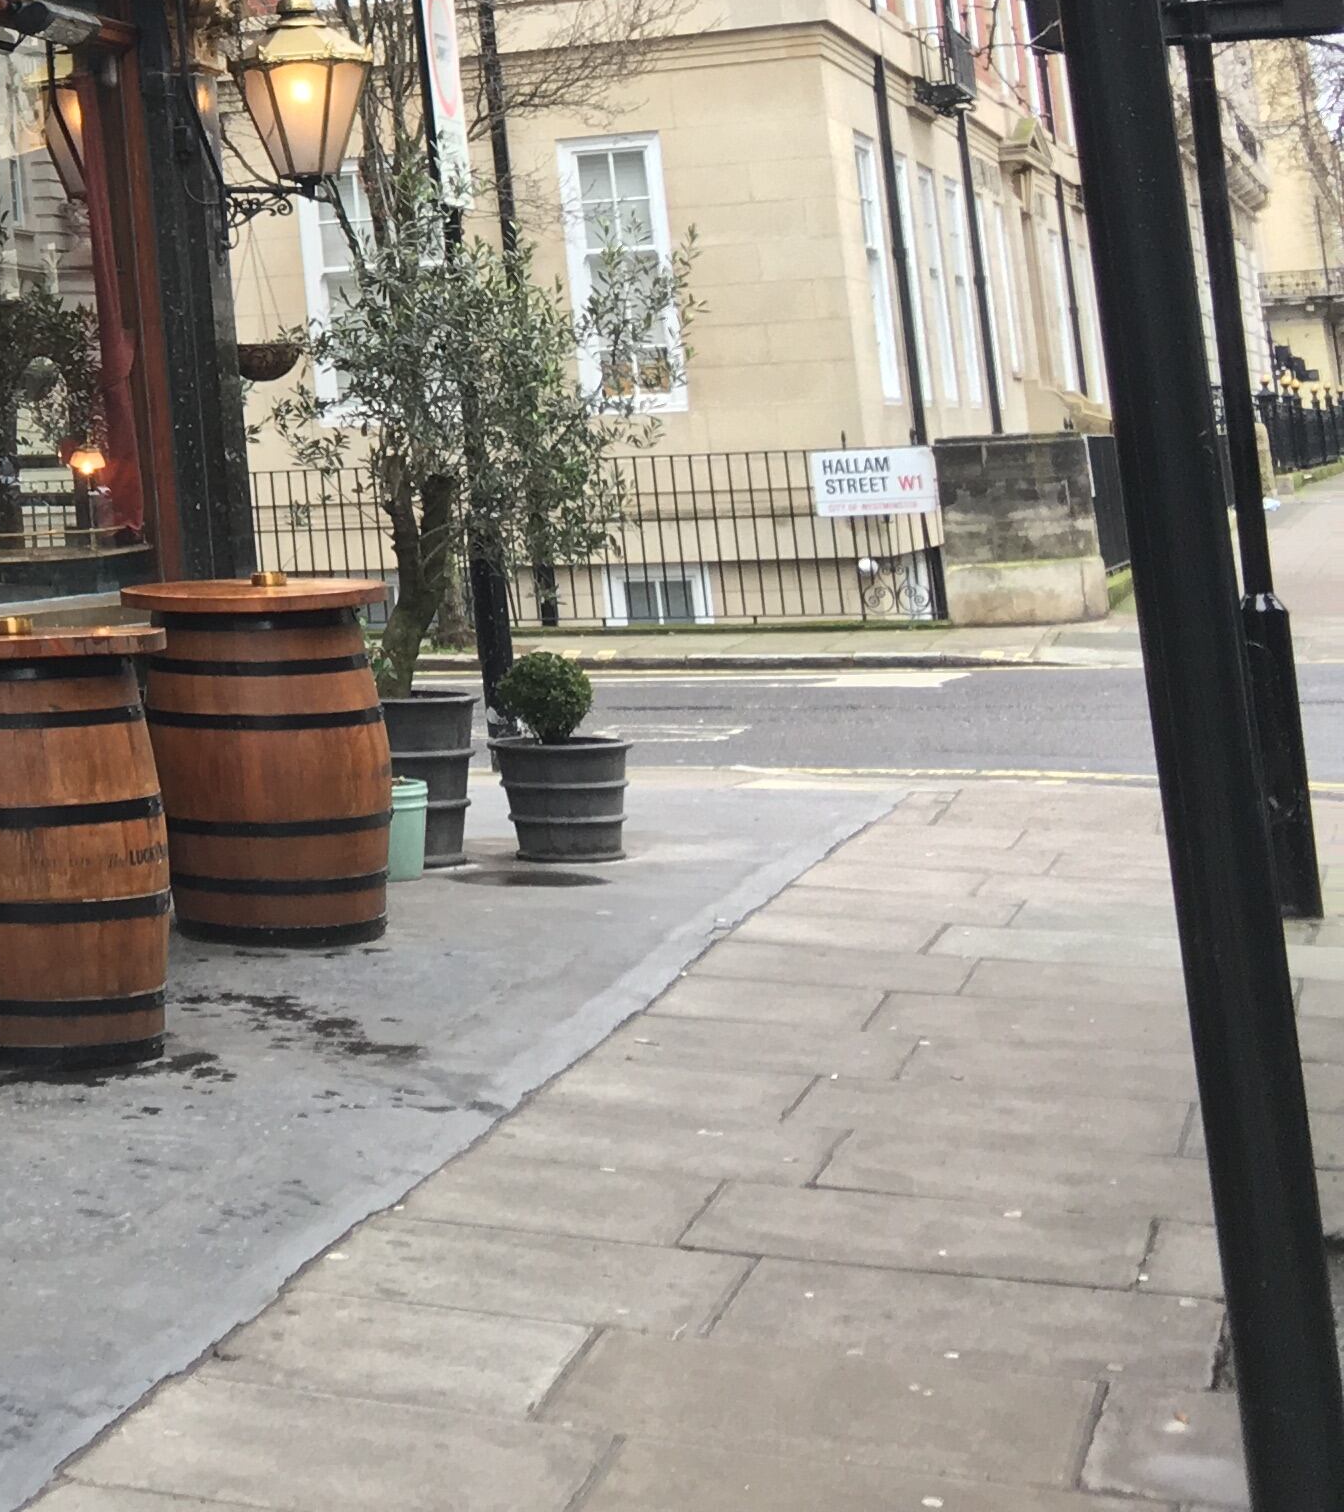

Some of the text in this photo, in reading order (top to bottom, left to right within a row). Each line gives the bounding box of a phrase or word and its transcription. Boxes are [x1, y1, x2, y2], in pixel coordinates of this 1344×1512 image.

[822, 456, 890, 475] HALLAM
[825, 474, 923, 495] STREET W1
